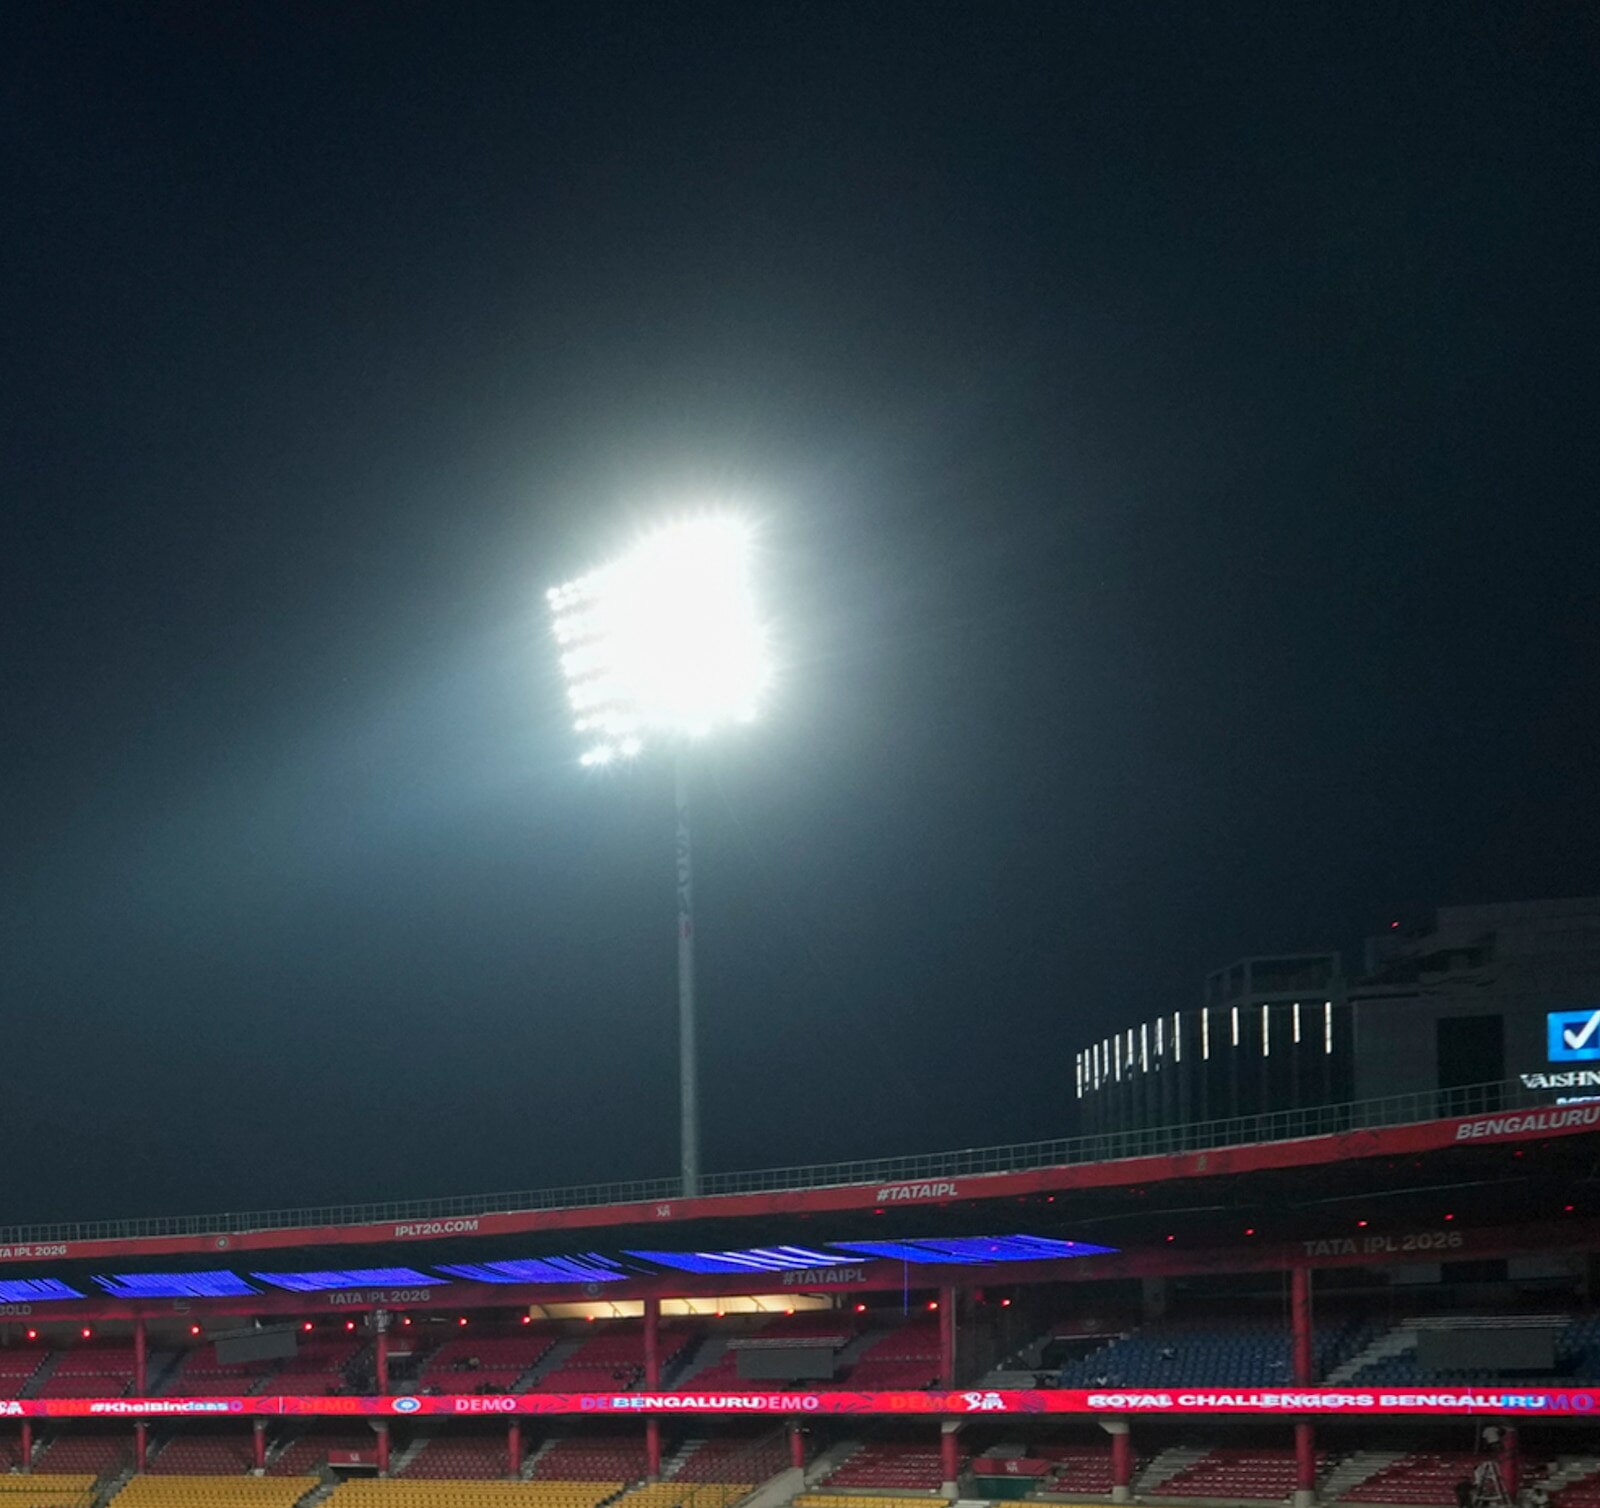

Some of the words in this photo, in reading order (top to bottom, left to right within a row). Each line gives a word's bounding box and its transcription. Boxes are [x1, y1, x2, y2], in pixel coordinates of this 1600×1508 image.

[876, 1183, 958, 1202] #TATAIPL
[395, 1220, 479, 1237] IPLT20.COM
[14, 1247, 33, 1257] IPL
[35, 1245, 67, 1256] 2026
[1303, 1238, 1358, 1257] TATA
[1362, 1236, 1398, 1253] IPL
[1402, 1231, 1463, 1251] 2026
[783, 1268, 866, 1285] #TATAIPL
[329, 1293, 363, 1305] TATA
[391, 1289, 431, 1302] 2026
[90, 1401, 229, 1413] #KhelBindaas
[455, 1398, 517, 1411] DEMO
[612, 1396, 760, 1409] BENGALURU
[1177, 1394, 1374, 1409] CHALLENGERS
[1380, 1394, 1546, 1408] BENGALURU
